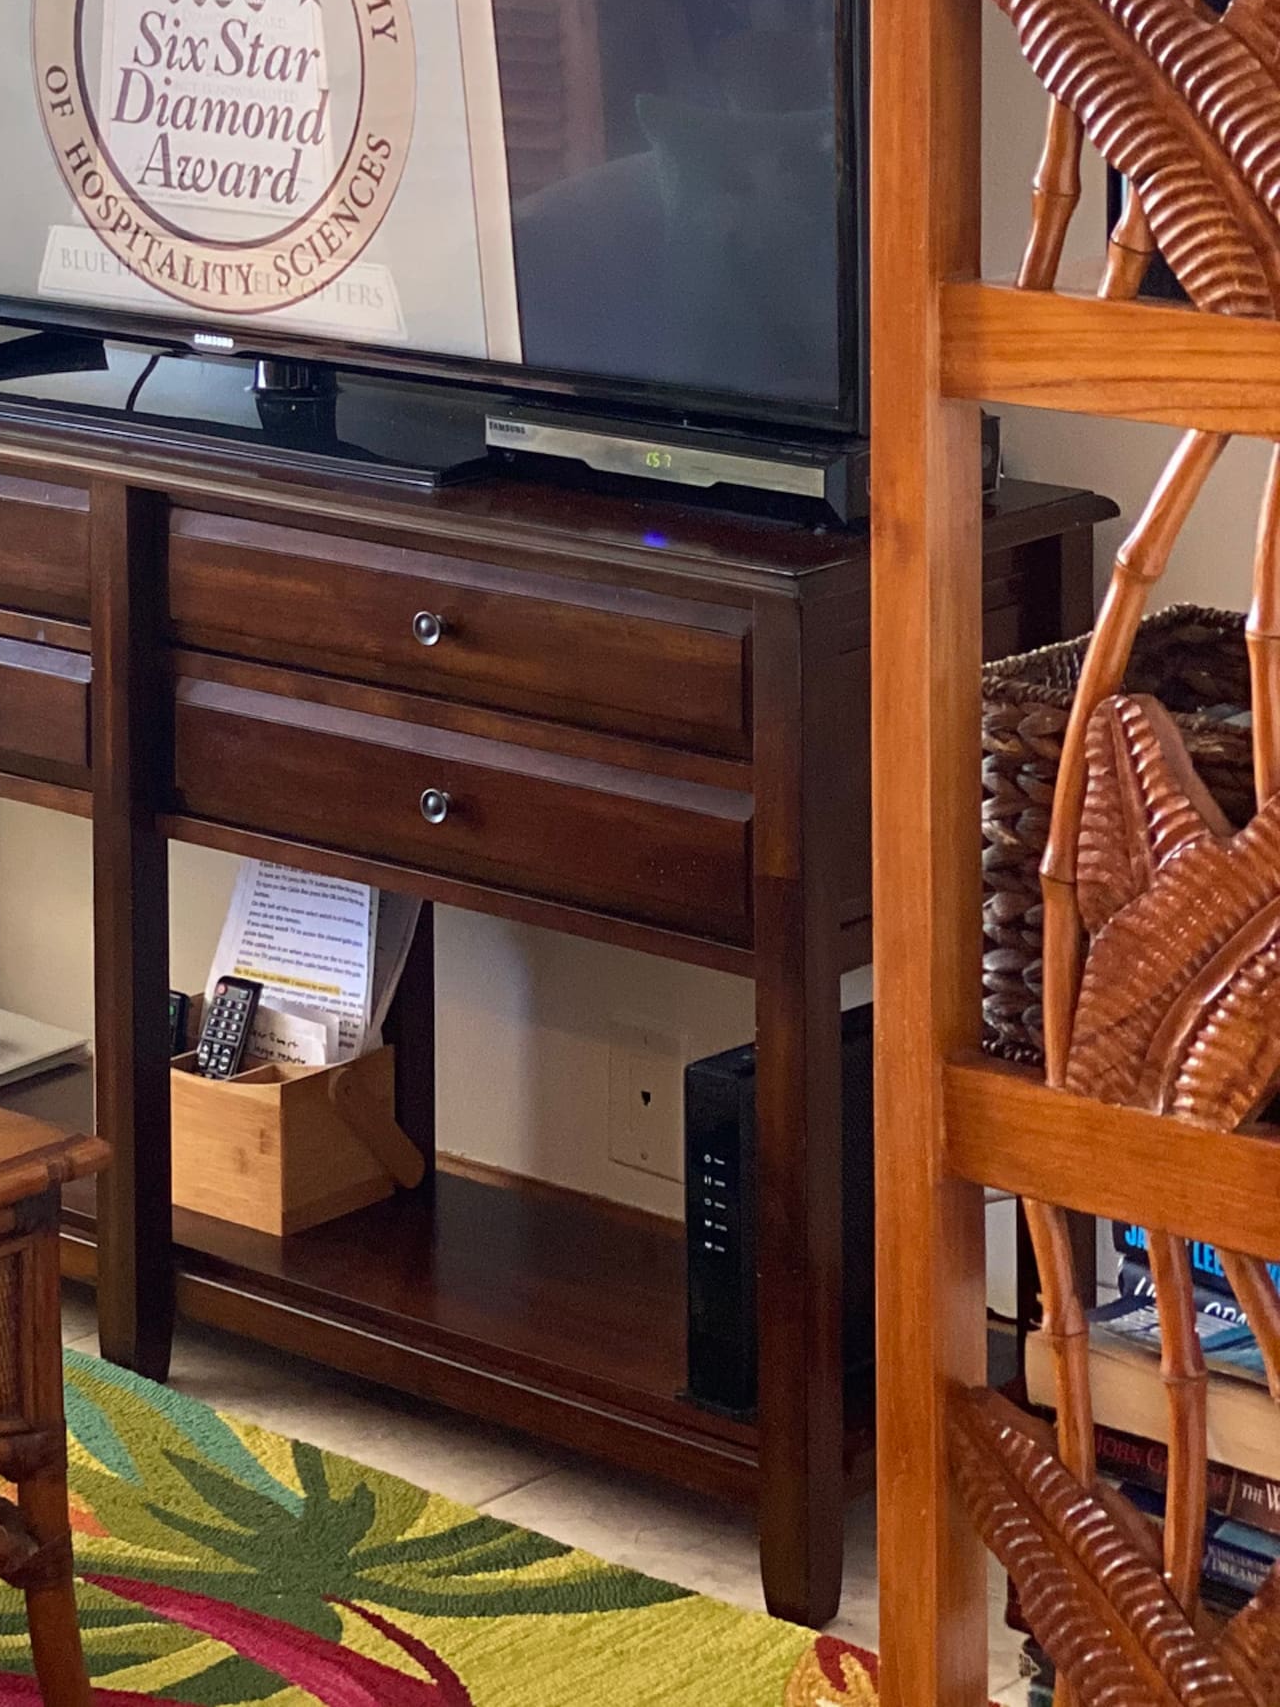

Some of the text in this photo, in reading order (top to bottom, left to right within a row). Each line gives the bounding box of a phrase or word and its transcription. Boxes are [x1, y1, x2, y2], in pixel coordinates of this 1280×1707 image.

[133, 10, 321, 83] Six Star
[111, 67, 330, 146] Diamond
[45, 65, 391, 295] OF HOSPITALITY SCIENCES
[137, 132, 302, 204] Award
[60, 247, 110, 274] BLUE
[194, 333, 234, 348] SAMSUNG
[488, 420, 526, 435] SAMSUNG
[1241, 1482, 1264, 1504] THE
